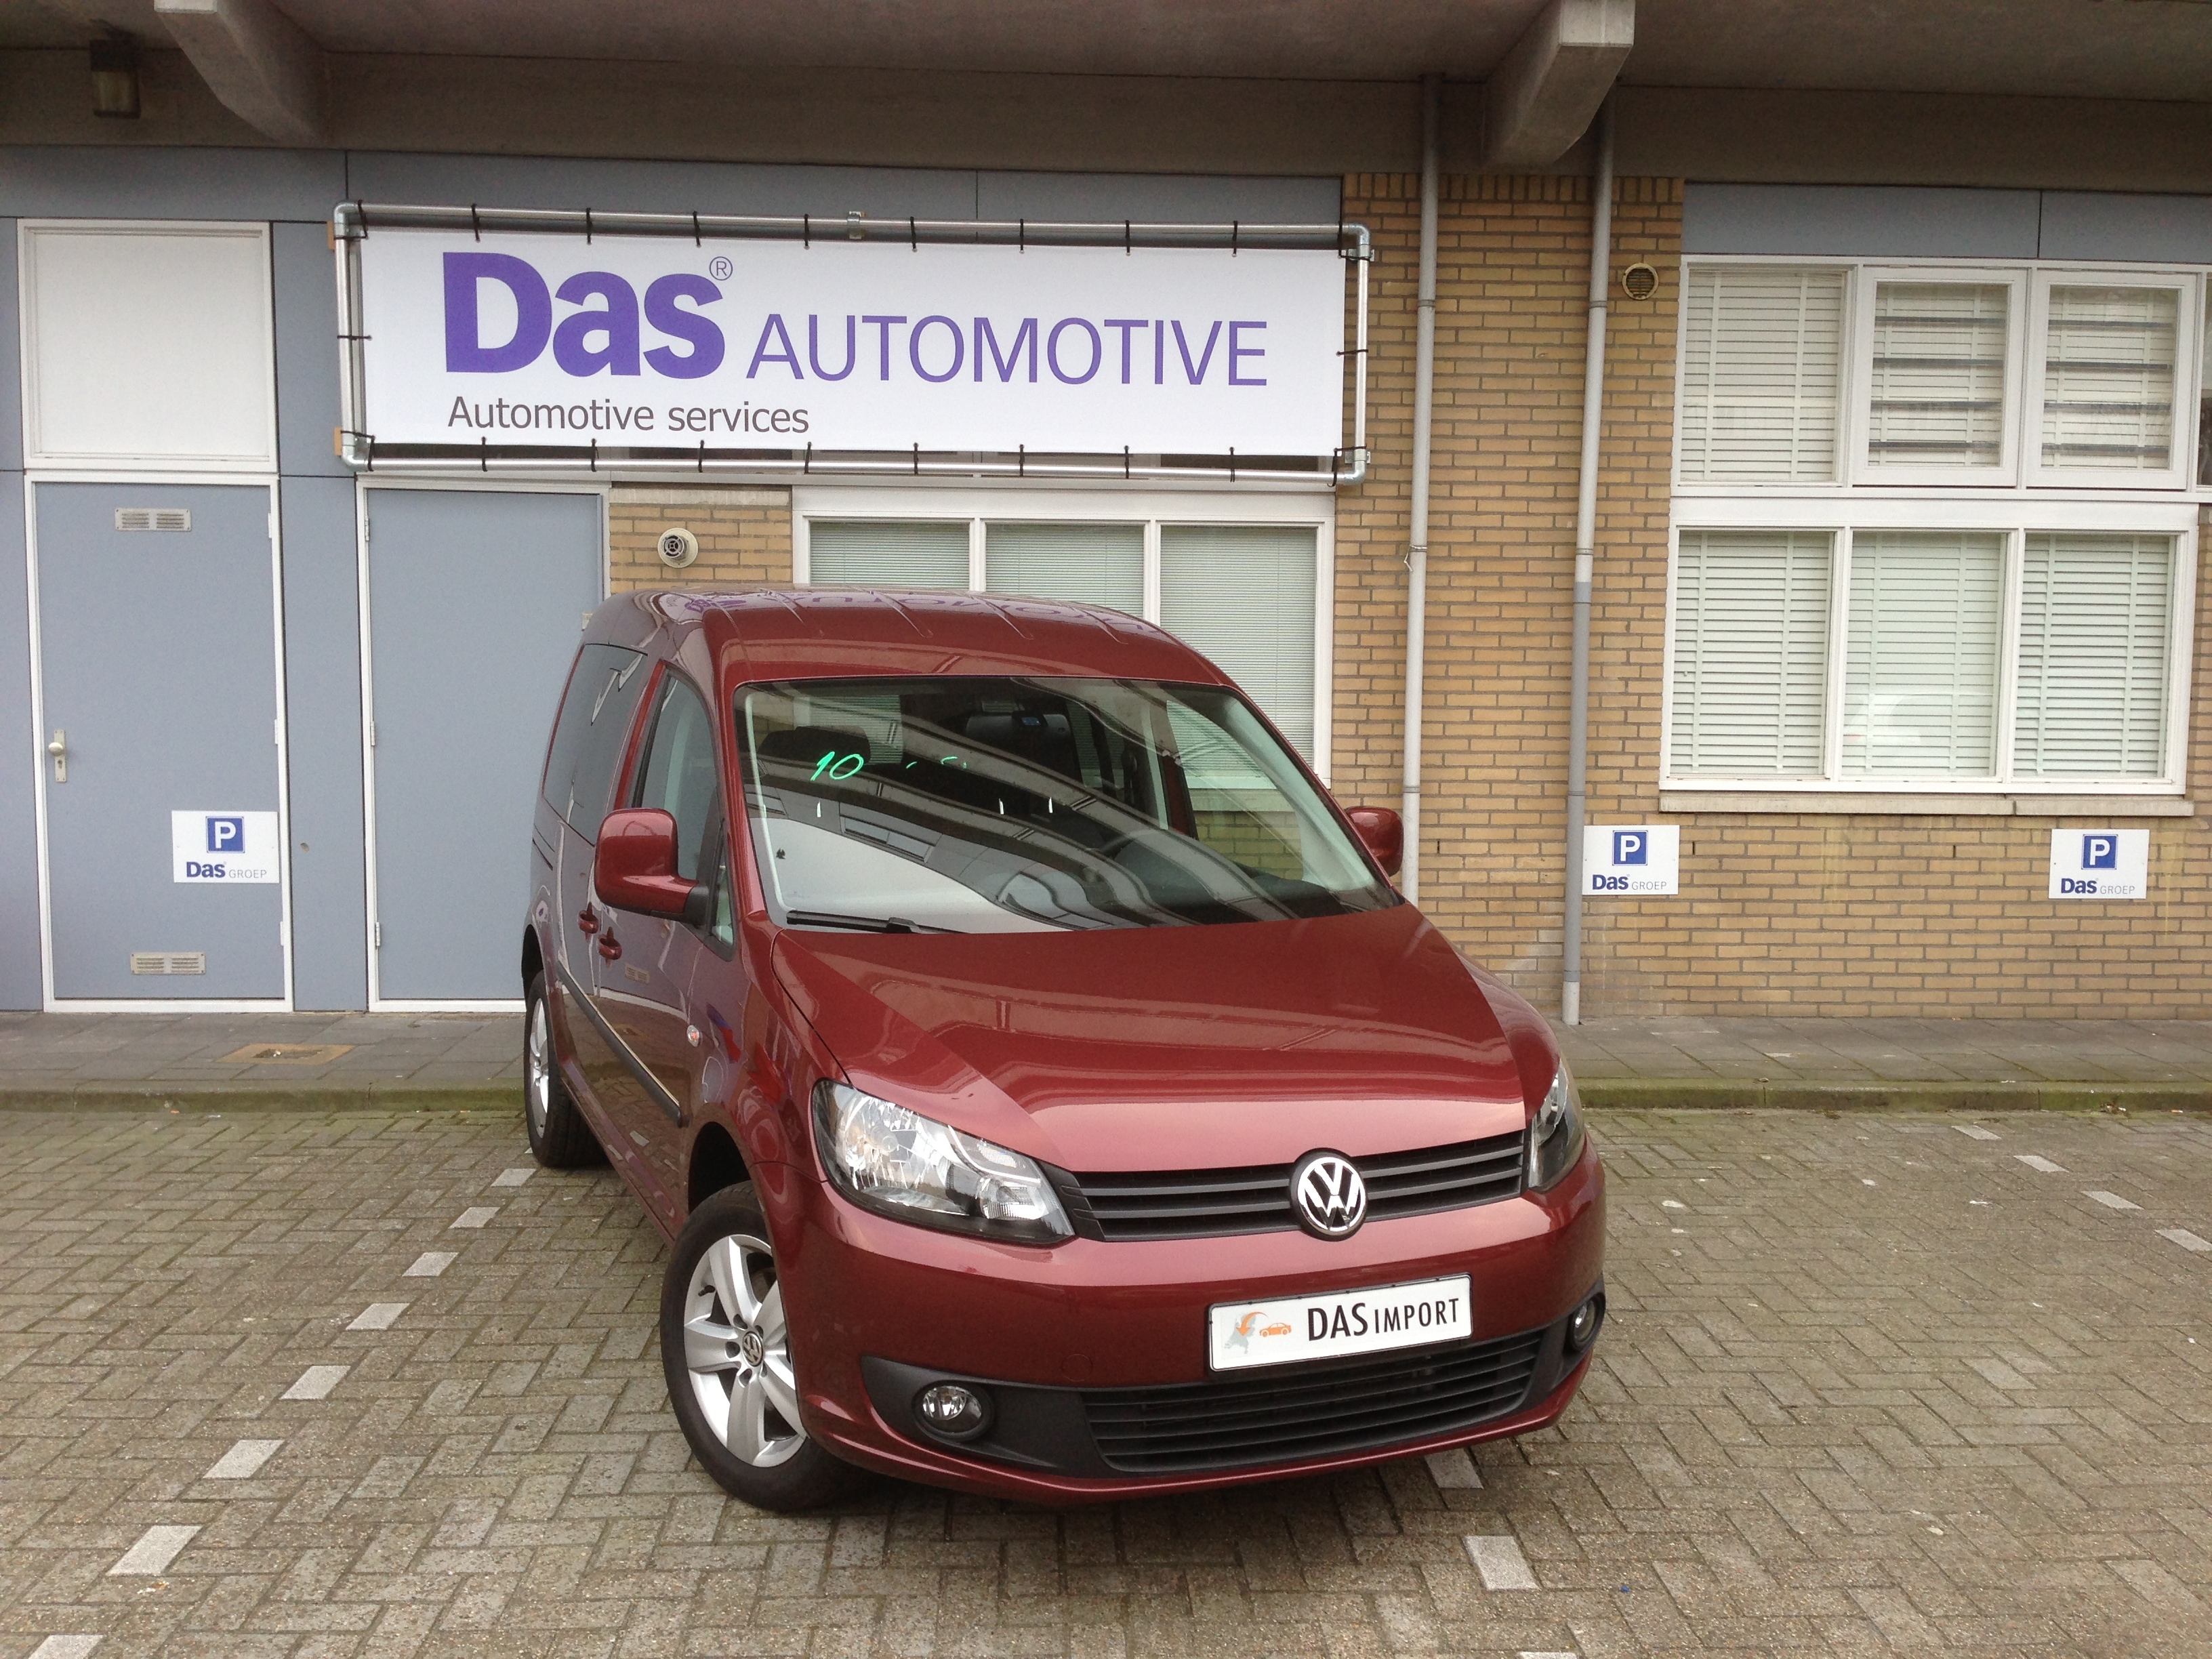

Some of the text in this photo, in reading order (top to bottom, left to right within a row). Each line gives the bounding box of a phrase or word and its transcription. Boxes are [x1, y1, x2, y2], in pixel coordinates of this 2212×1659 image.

[746, 313, 1267, 387] AUTOMOTIVE
[447, 396, 809, 434] Automotive services
[811, 751, 864, 781] 10
[214, 821, 237, 849] P
[1620, 835, 1641, 862] P
[2089, 839, 2110, 865] P
[186, 861, 267, 879] Das GROEP
[1593, 874, 1667, 890] Das GROEP
[2061, 878, 2135, 895] Das GROEP
[1307, 1297, 1459, 1342] DAS IMPORT
